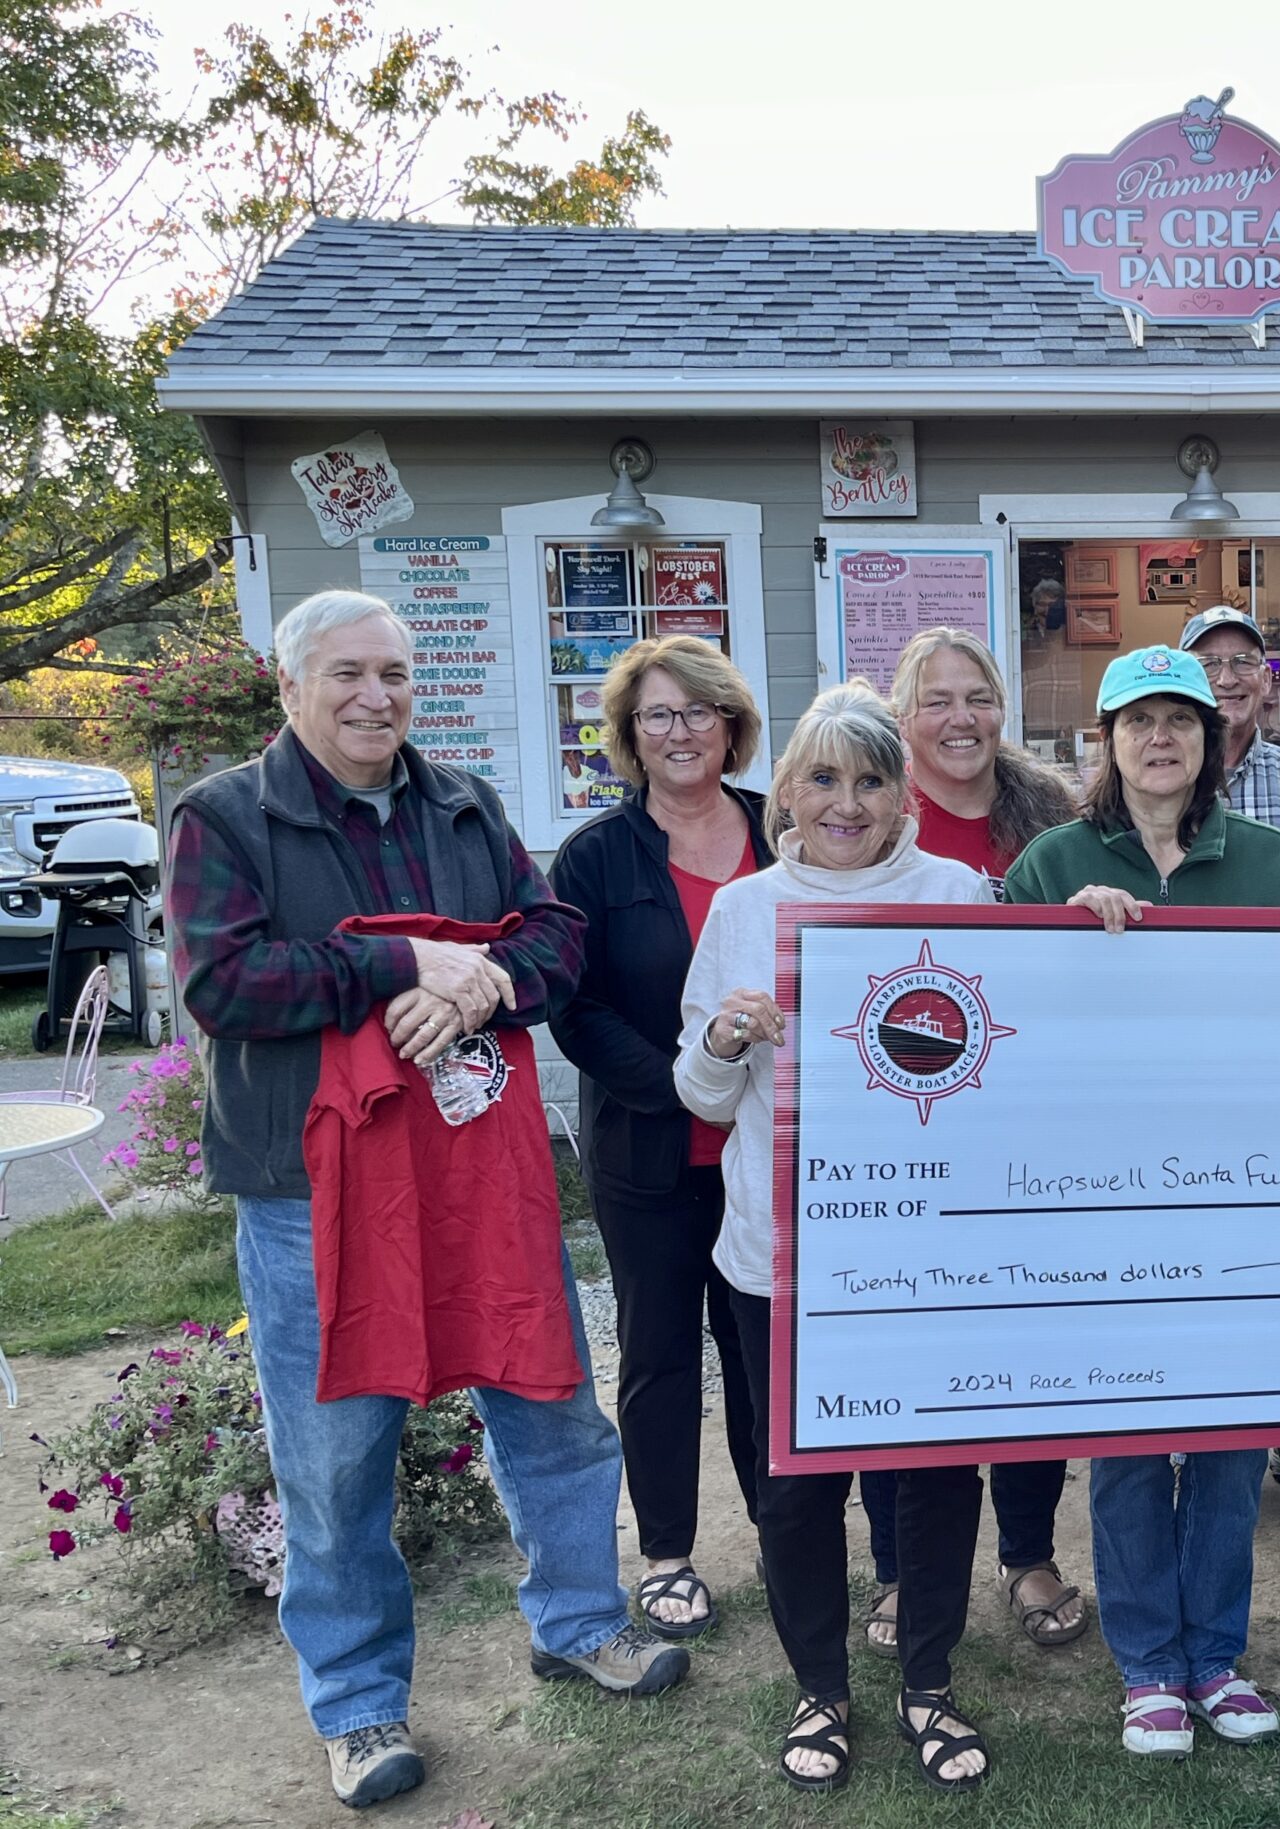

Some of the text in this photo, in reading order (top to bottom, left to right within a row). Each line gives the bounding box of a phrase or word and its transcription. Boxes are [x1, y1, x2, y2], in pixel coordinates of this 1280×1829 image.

[1062, 207, 1144, 248] ICE
[832, 427, 863, 458] The
[300, 452, 354, 495] Talia's
[317, 462, 389, 521] Strawberry
[827, 469, 910, 511] Bentley
[336, 483, 397, 536] Shortcake
[385, 538, 479, 551] Hard Ice Cream
[408, 555, 458, 567] VANILLA
[657, 561, 715, 572] LOBSTOBER
[847, 563, 900, 571] ICE CREAM
[399, 570, 470, 583] CHOCOLATE
[675, 571, 700, 580] FEST
[414, 587, 458, 599] COFFEE
[423, 603, 490, 615] RASPBERRY
[460, 620, 488, 631] CHIP
[456, 635, 476, 648] JOY
[430, 652, 469, 664] HEATH
[472, 651, 496, 663] BAR
[442, 667, 486, 679] DOUGH
[440, 684, 483, 695] TRACKS
[421, 701, 465, 712] GINGER
[412, 715, 475, 728] GRAPENUT
[407, 732, 488, 745] EMON SORBET
[428, 749, 464, 761] CHOC.
[466, 748, 495, 760] CHIP
[591, 784, 624, 798] Flake
[870, 975, 979, 1018] HARPSWELL, MAINE
[869, 1042, 979, 1089] LOBSTER BOAT RACES
[864, 1163, 896, 1181] TO
[905, 1161, 950, 1180] THE
[1007, 1161, 1146, 1200] Harpswell
[1161, 1156, 1236, 1189] Santa
[807, 1200, 927, 1220] ORDER OF
[831, 1268, 918, 1298] Twenty
[925, 1267, 994, 1287] Three
[998, 1263, 1108, 1285] Thousand
[1120, 1262, 1203, 1283] dollars
[948, 1367, 1165, 1393] 2024 Race Proceeds
